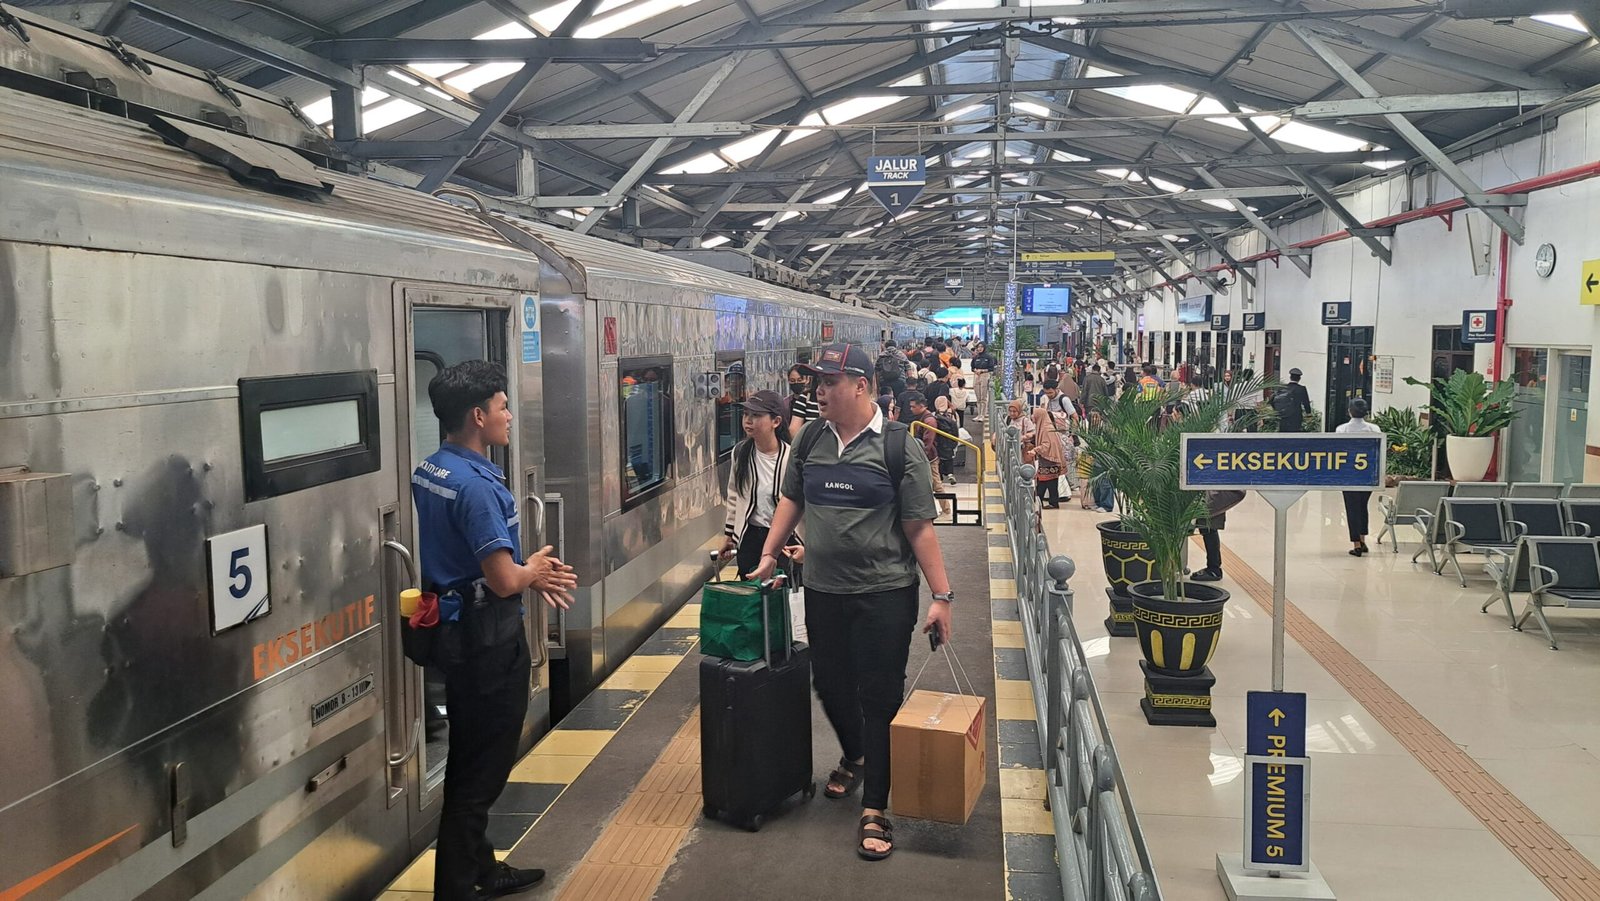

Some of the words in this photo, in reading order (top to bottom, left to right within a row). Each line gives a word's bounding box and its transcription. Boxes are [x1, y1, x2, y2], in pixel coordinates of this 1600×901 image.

[875, 159, 917, 170] JALUR
[890, 193, 901, 206] 1
[1217, 452, 1348, 470] EKSEKUTIF
[1354, 453, 1368, 470] 5
[824, 482, 854, 491] KANGOL
[229, 547, 252, 599] 5
[253, 594, 375, 681] EKSEKUTIF
[315, 696, 339, 720] NOMOR
[1267, 735, 1286, 840] PREMIUM
[1266, 845, 1284, 857] 5
